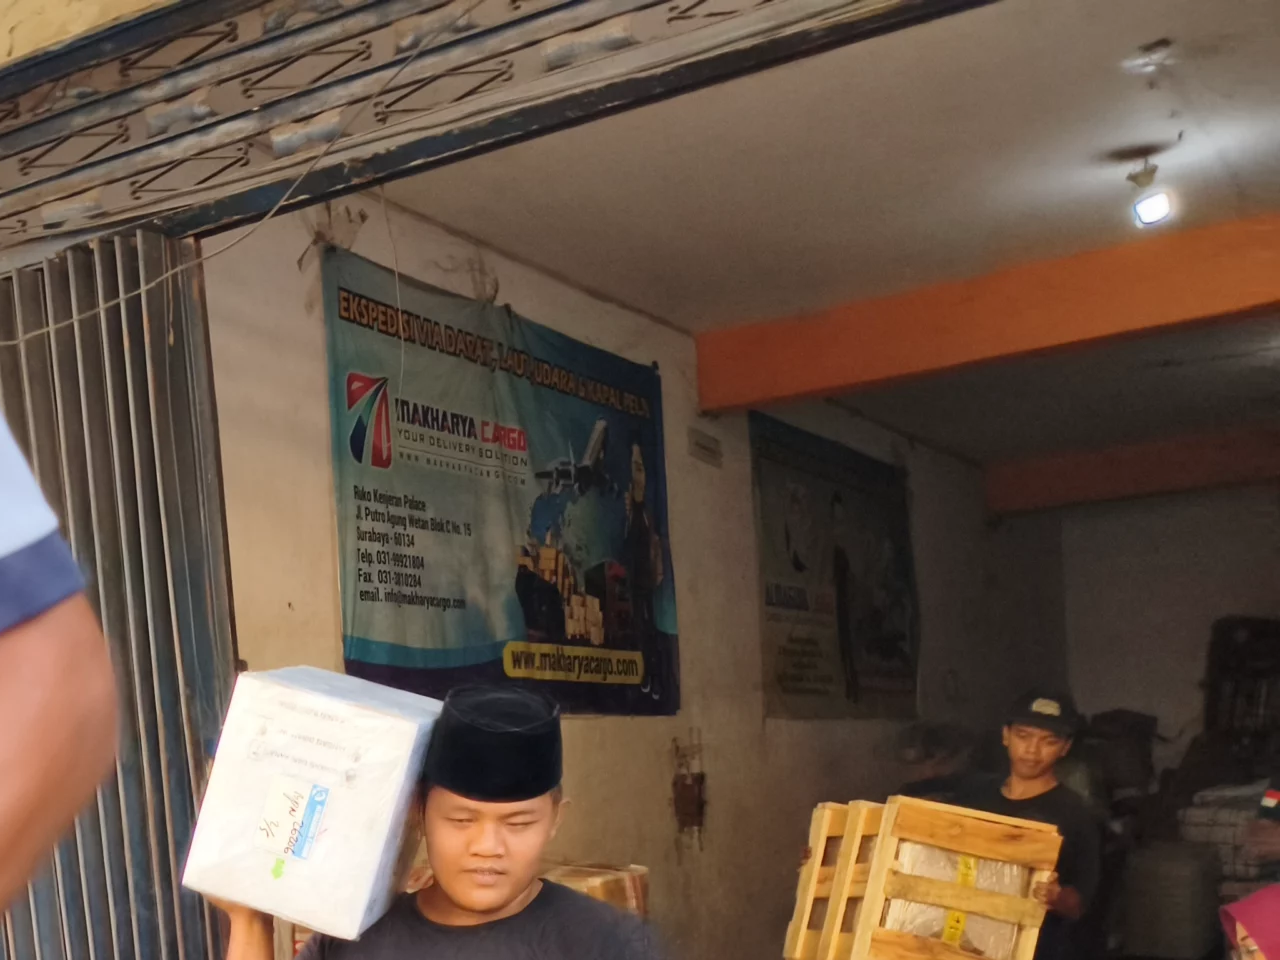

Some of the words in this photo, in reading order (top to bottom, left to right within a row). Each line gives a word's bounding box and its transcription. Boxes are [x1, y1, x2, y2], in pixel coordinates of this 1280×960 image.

[397, 428, 424, 444] YOUR
[429, 435, 474, 455] DELIVERY
[354, 484, 370, 502] Ruko
[373, 488, 401, 511] Kenjeran
[403, 494, 425, 512] Palace
[364, 506, 385, 524] Putro
[386, 510, 406, 530] Agung
[408, 514, 428, 530] Wetan
[430, 516, 444, 533] Blok
[452, 521, 462, 535] No.
[463, 522, 471, 537] 15
[356, 525, 389, 547] Surabaya
[393, 531, 414, 548] 60134
[357, 548, 374, 566] Telp.
[358, 567, 373, 582] Fax.
[511, 646, 638, 681] www.makharyacargo.com
